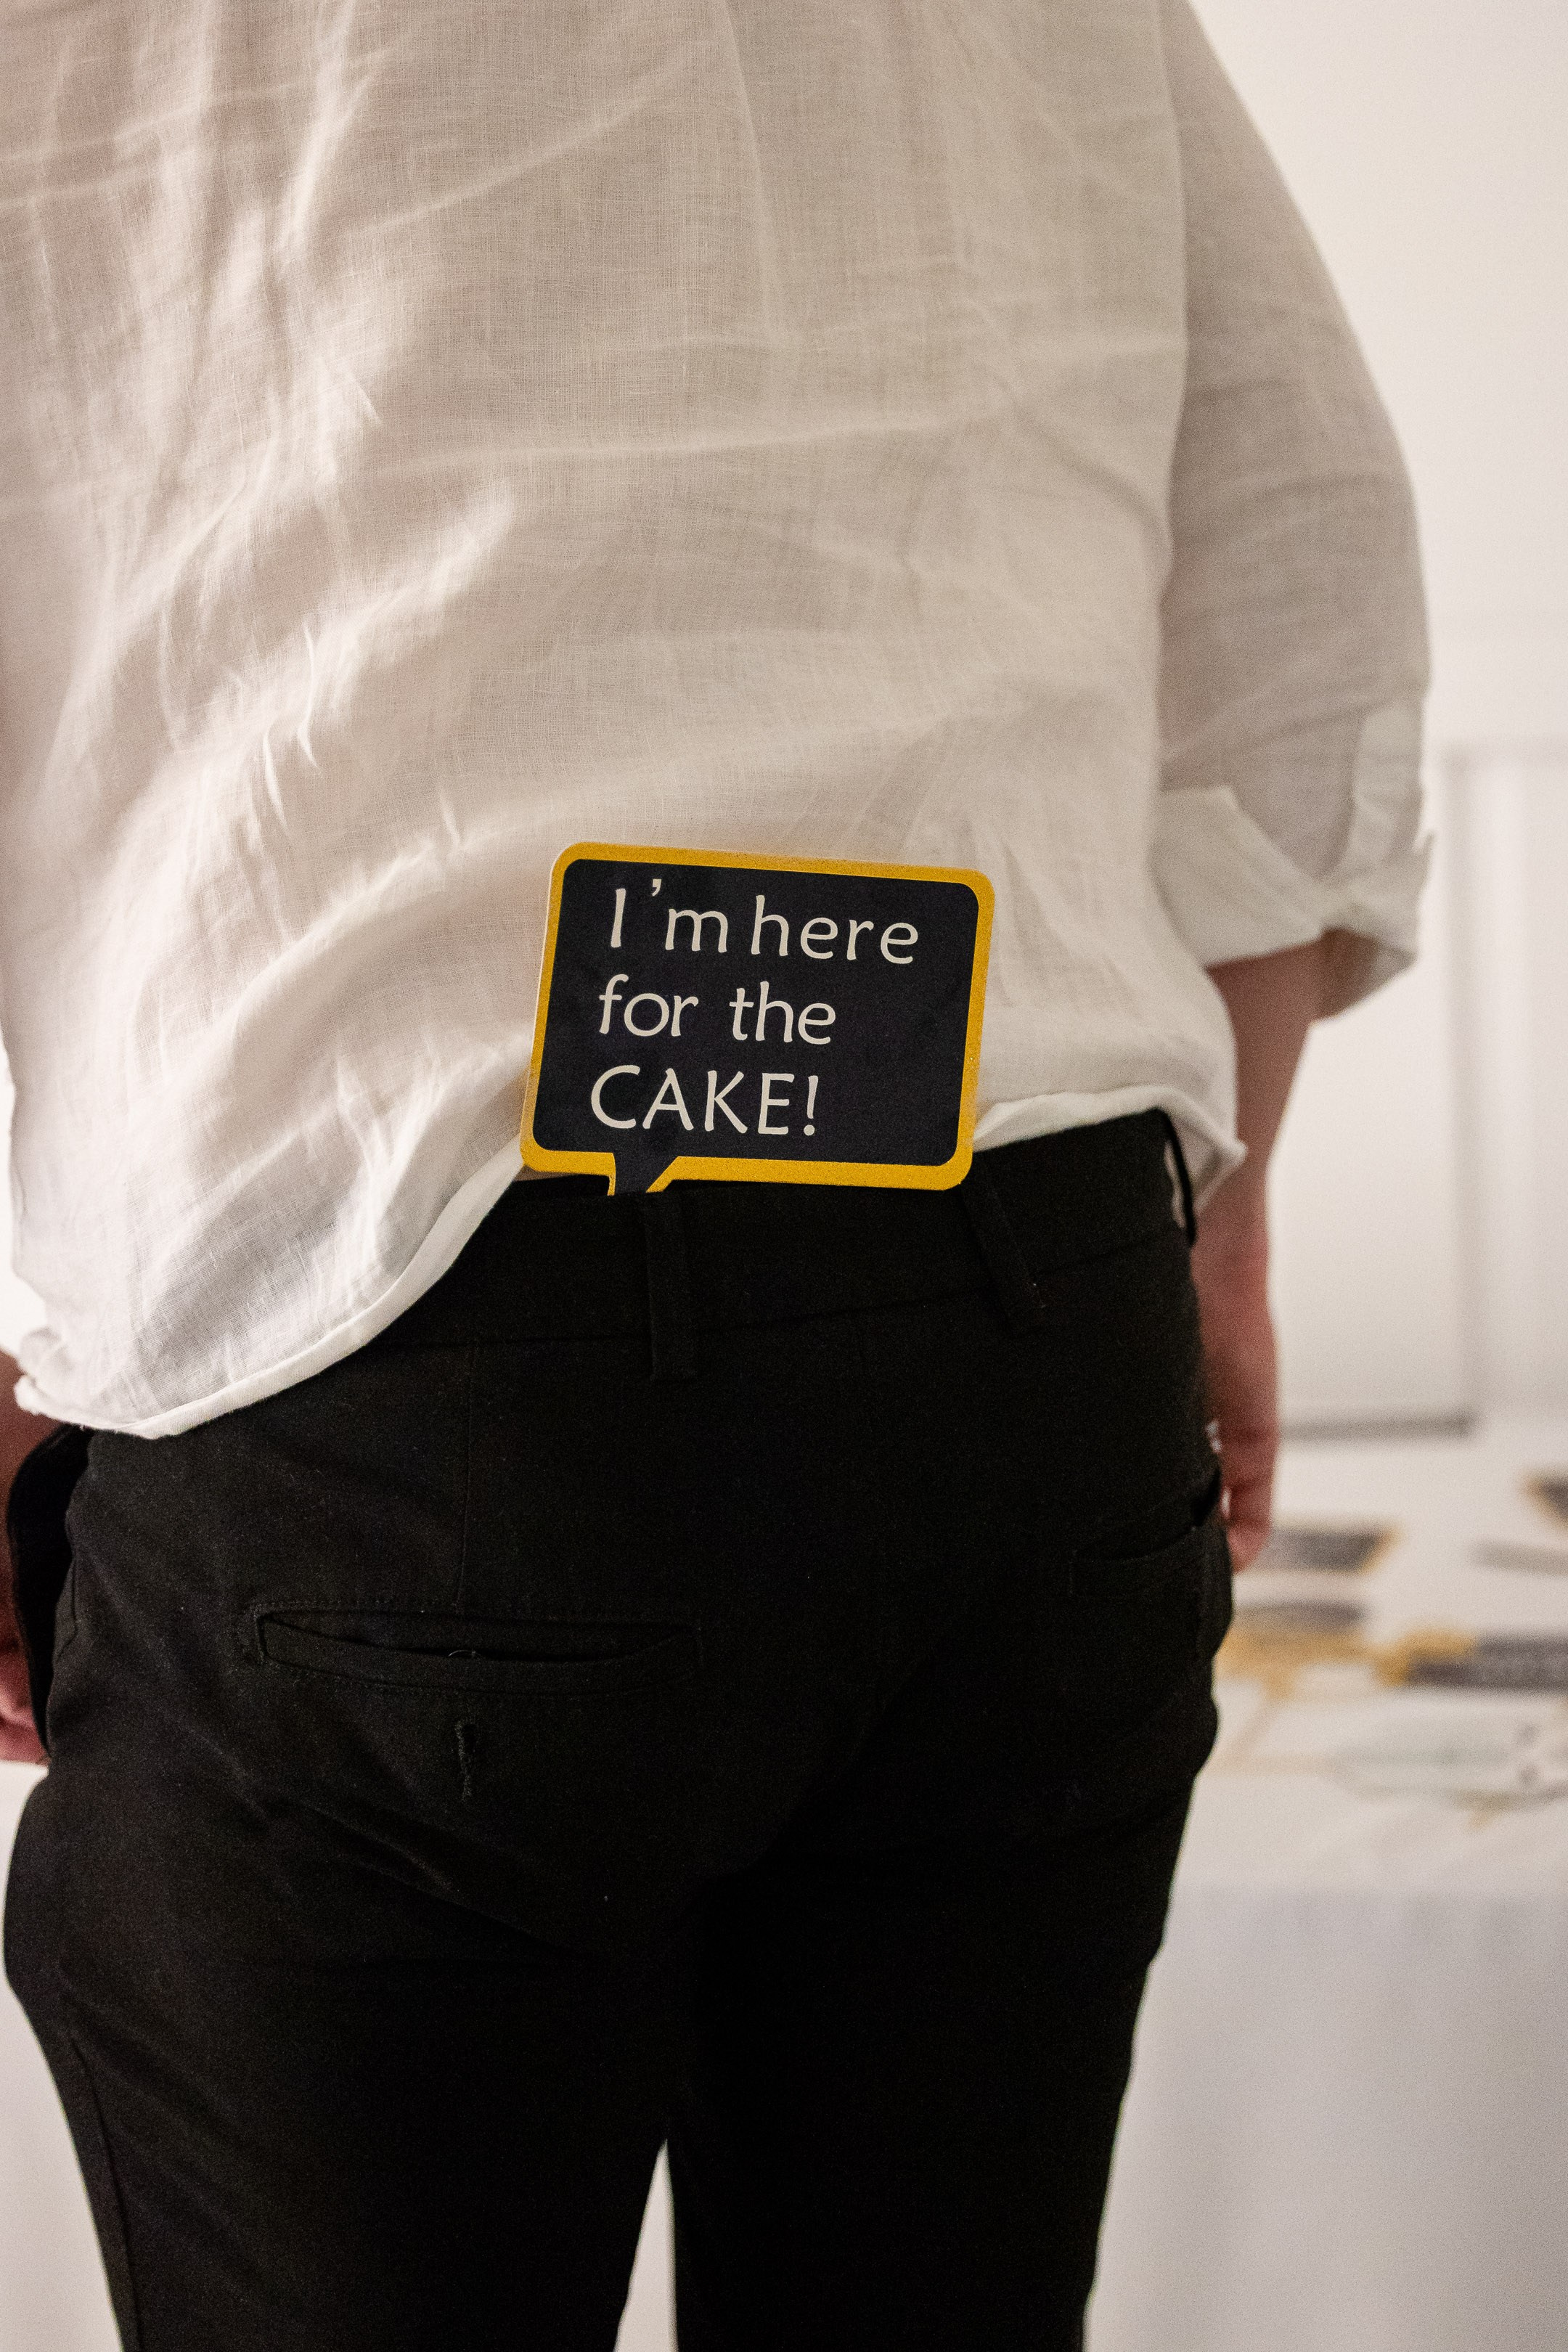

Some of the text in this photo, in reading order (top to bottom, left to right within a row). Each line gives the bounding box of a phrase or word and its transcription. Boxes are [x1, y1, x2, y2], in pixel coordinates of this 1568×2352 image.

[610, 878, 918, 965] I'm here
[598, 973, 836, 1045] for the
[590, 1064, 819, 1136] CAKE!
